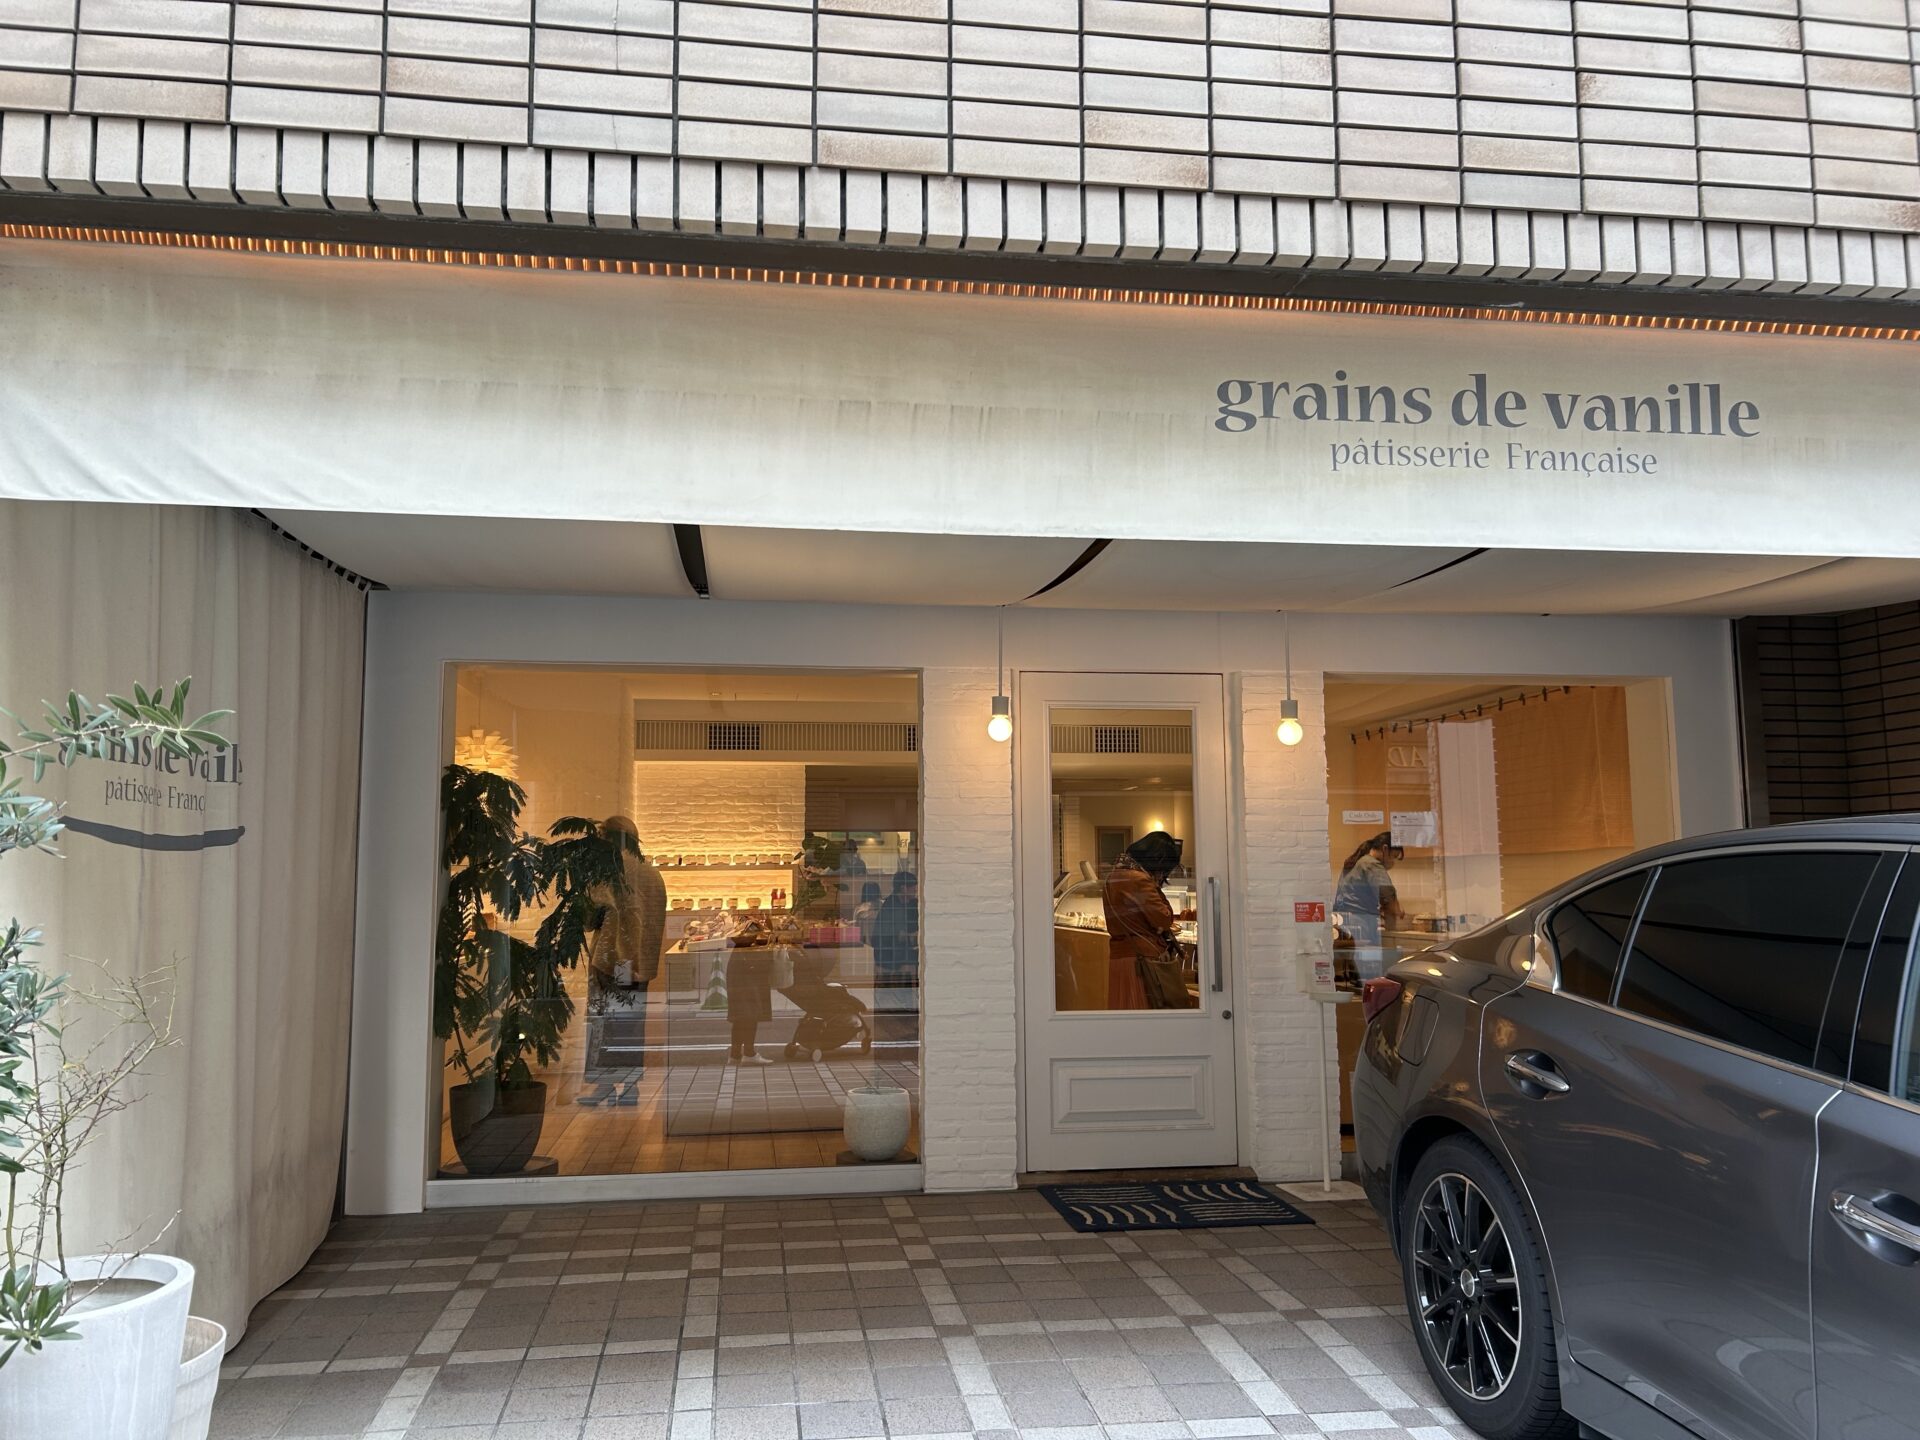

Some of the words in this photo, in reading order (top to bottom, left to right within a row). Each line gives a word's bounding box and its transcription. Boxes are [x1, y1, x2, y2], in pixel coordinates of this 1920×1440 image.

[1214, 370, 1432, 432] grains
[1451, 373, 1527, 428] de
[1542, 383, 1760, 437] vanille
[1330, 437, 1489, 471] pâtisserie
[1505, 442, 1657, 476] Française
